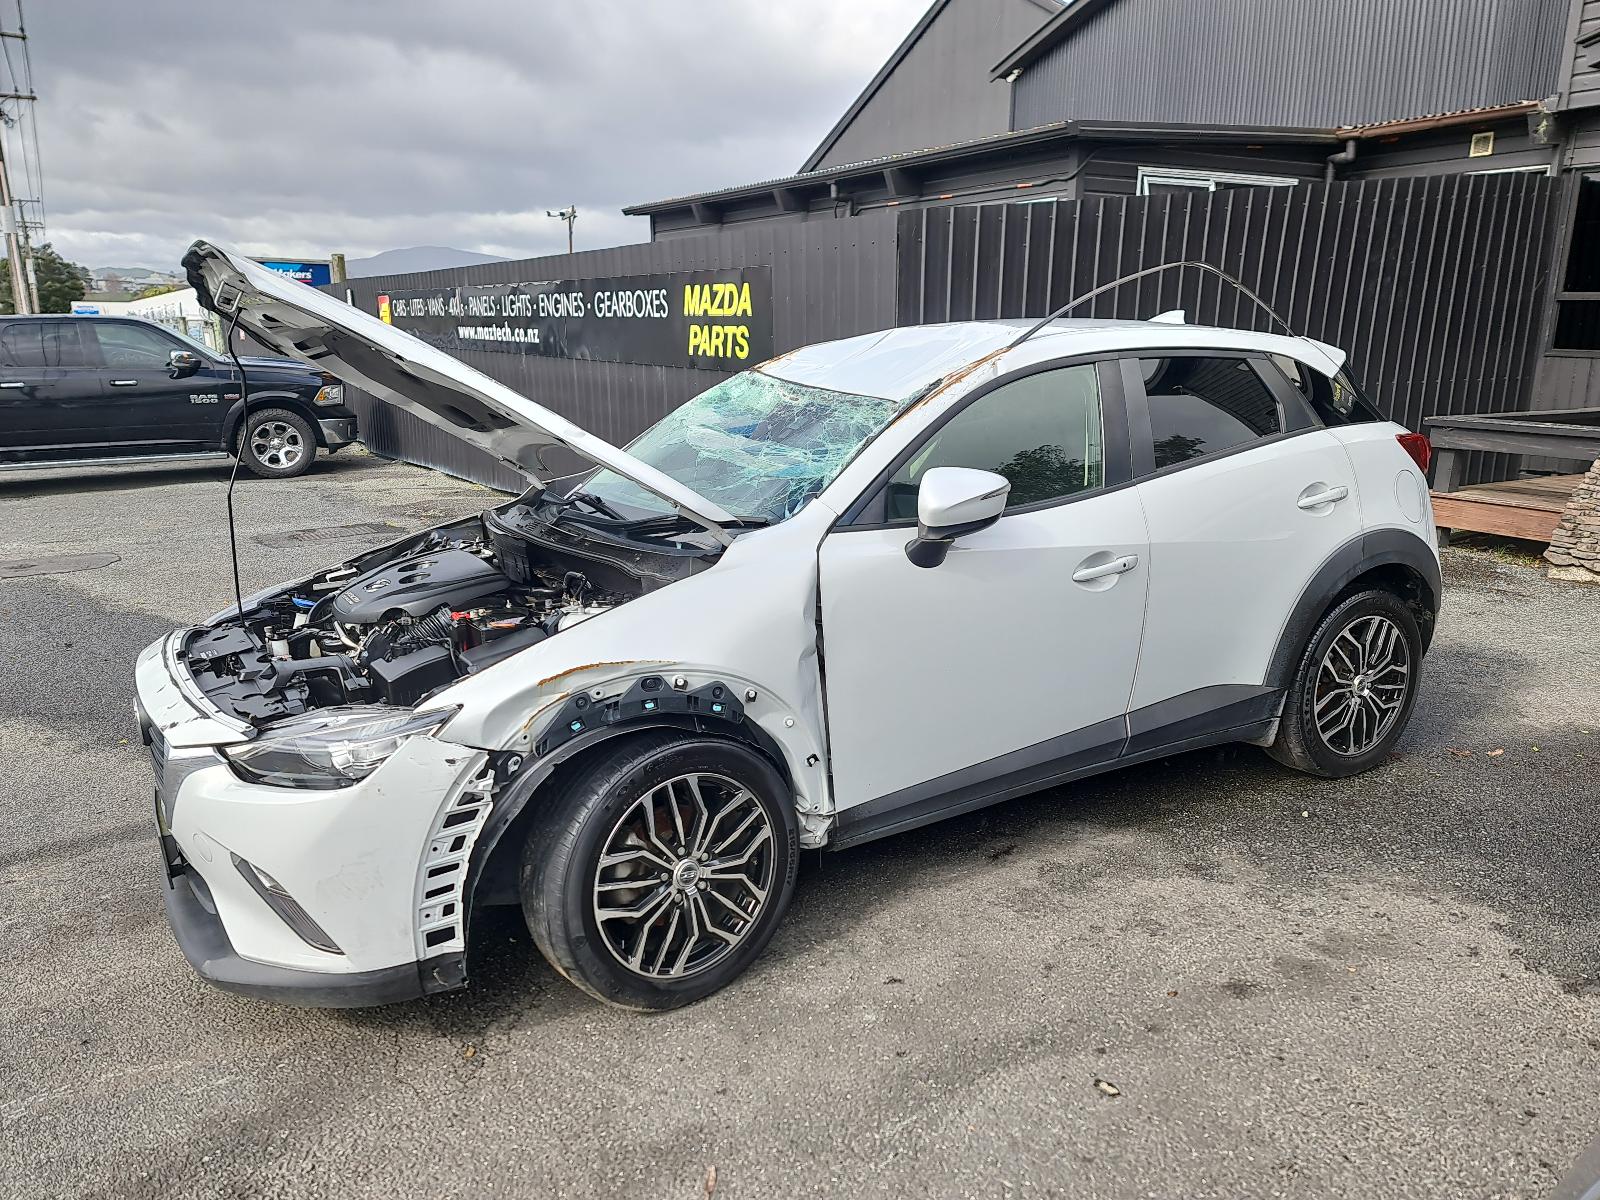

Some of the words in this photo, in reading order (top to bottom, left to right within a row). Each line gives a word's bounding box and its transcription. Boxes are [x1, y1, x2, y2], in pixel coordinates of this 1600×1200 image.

[392, 299, 407, 317] CARS
[409, 298, 425, 317] UTES
[427, 297, 445, 317] VANS
[468, 295, 496, 317] PANELS
[501, 294, 532, 317] LIGHTS
[538, 292, 585, 318] ENGINES
[594, 288, 669, 318] GEARBOXES
[683, 282, 753, 317] MAZDA
[457, 321, 540, 343] www.maztech.co.nz
[688, 324, 750, 360] PARTS
